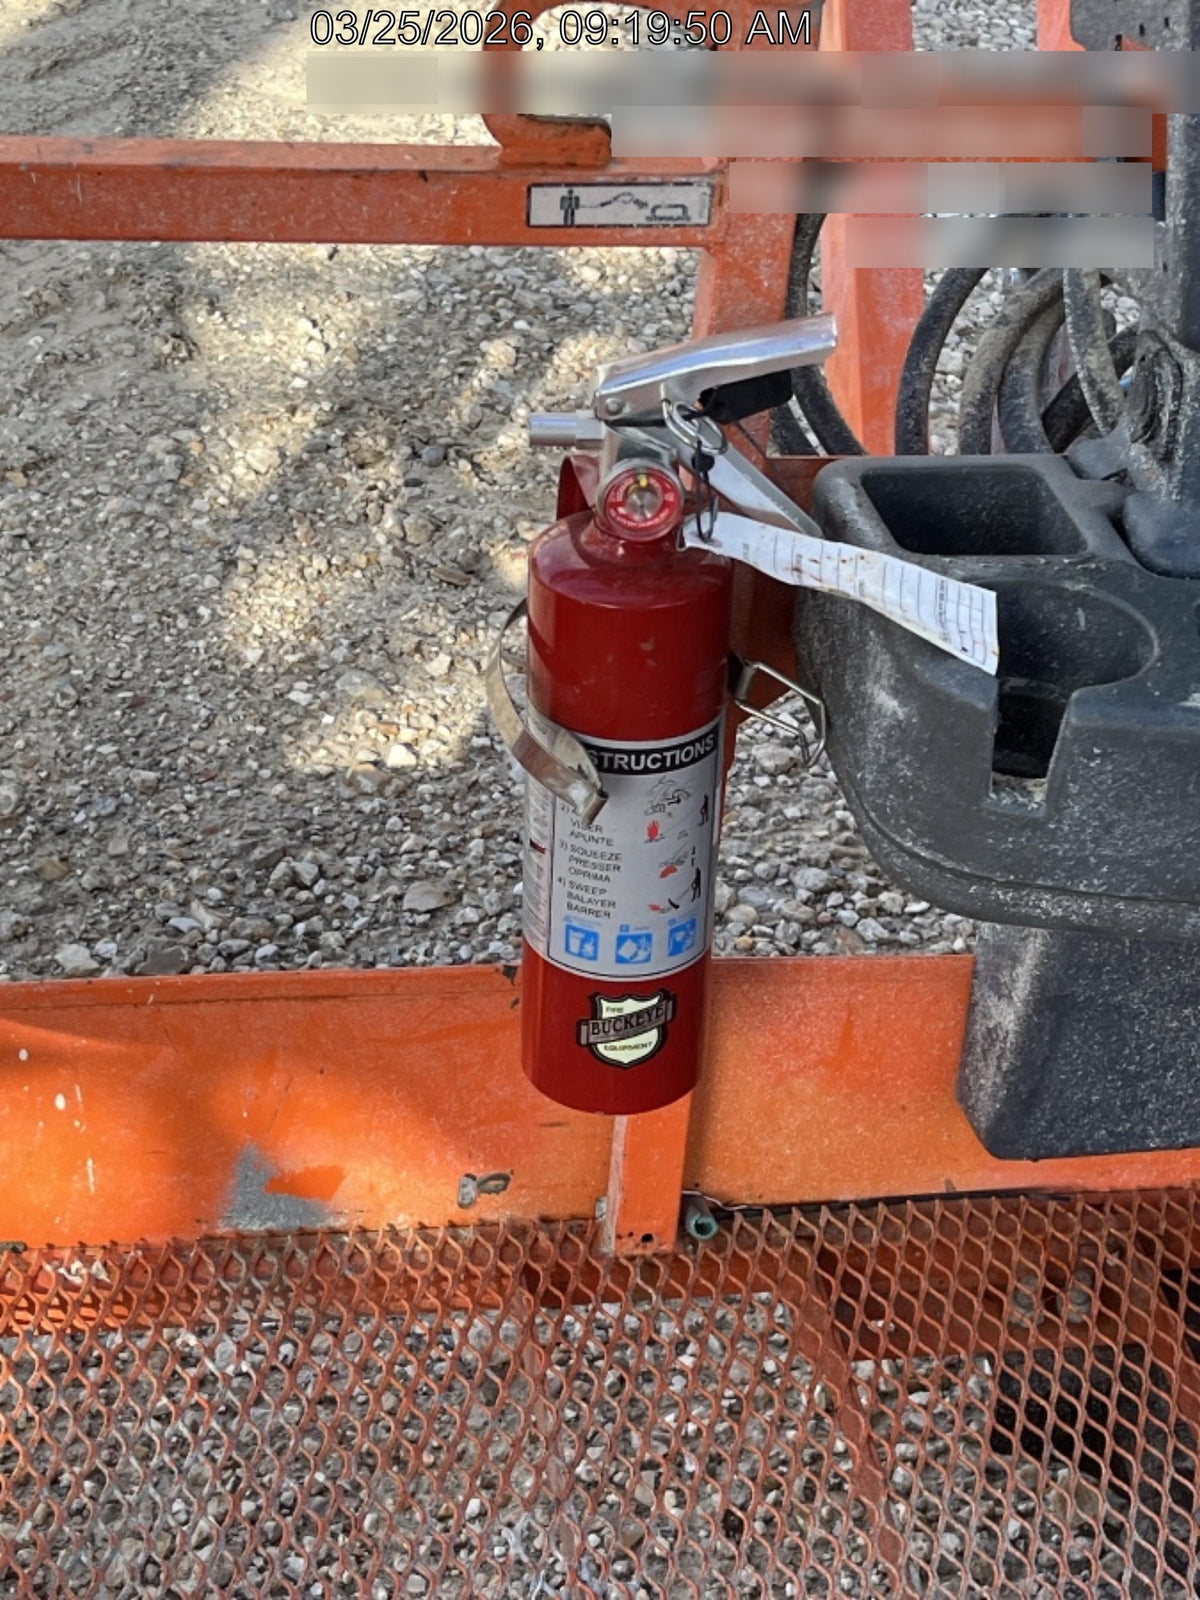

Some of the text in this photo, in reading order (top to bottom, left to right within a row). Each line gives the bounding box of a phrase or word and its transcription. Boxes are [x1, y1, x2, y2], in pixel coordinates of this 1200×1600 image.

[589, 734, 714, 771] STRUCTIONS
[570, 831, 614, 846] APUNTE
[570, 844, 622, 861] SQUEEZE
[568, 855, 621, 872] PRESSER
[568, 866, 610, 883] OPRIMA
[568, 880, 607, 896] SWEEP
[566, 891, 616, 909] BALAYER
[566, 903, 610, 919] BARRER
[591, 1004, 665, 1036] BUCKEYE
[604, 1041, 653, 1051] EQUIPMENT
